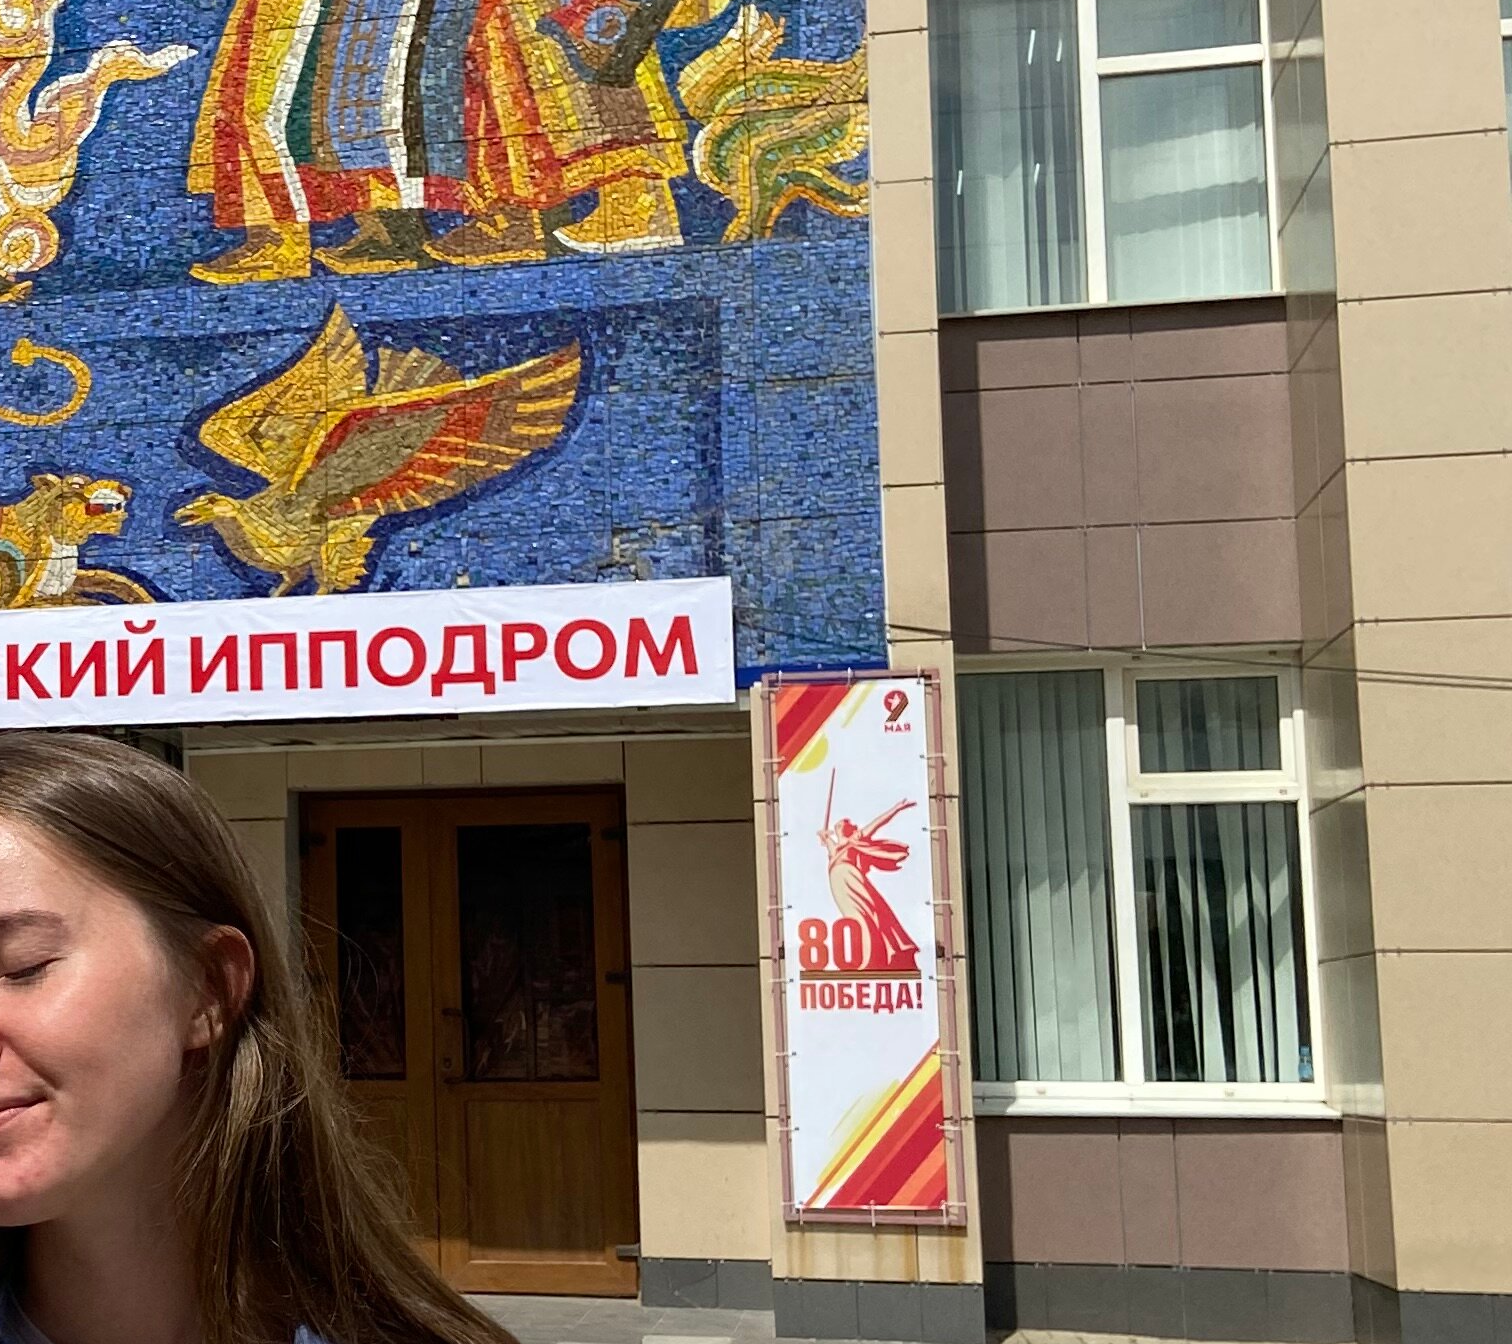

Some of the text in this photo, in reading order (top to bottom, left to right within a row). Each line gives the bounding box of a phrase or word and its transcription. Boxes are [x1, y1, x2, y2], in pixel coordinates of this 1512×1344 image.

[189, 615, 699, 697] ИППОДРОМ
[883, 690, 909, 722] 9
[884, 723, 911, 733] МАЯ
[798, 918, 864, 971] 80
[799, 982, 923, 1014] ПОБЕДА!
